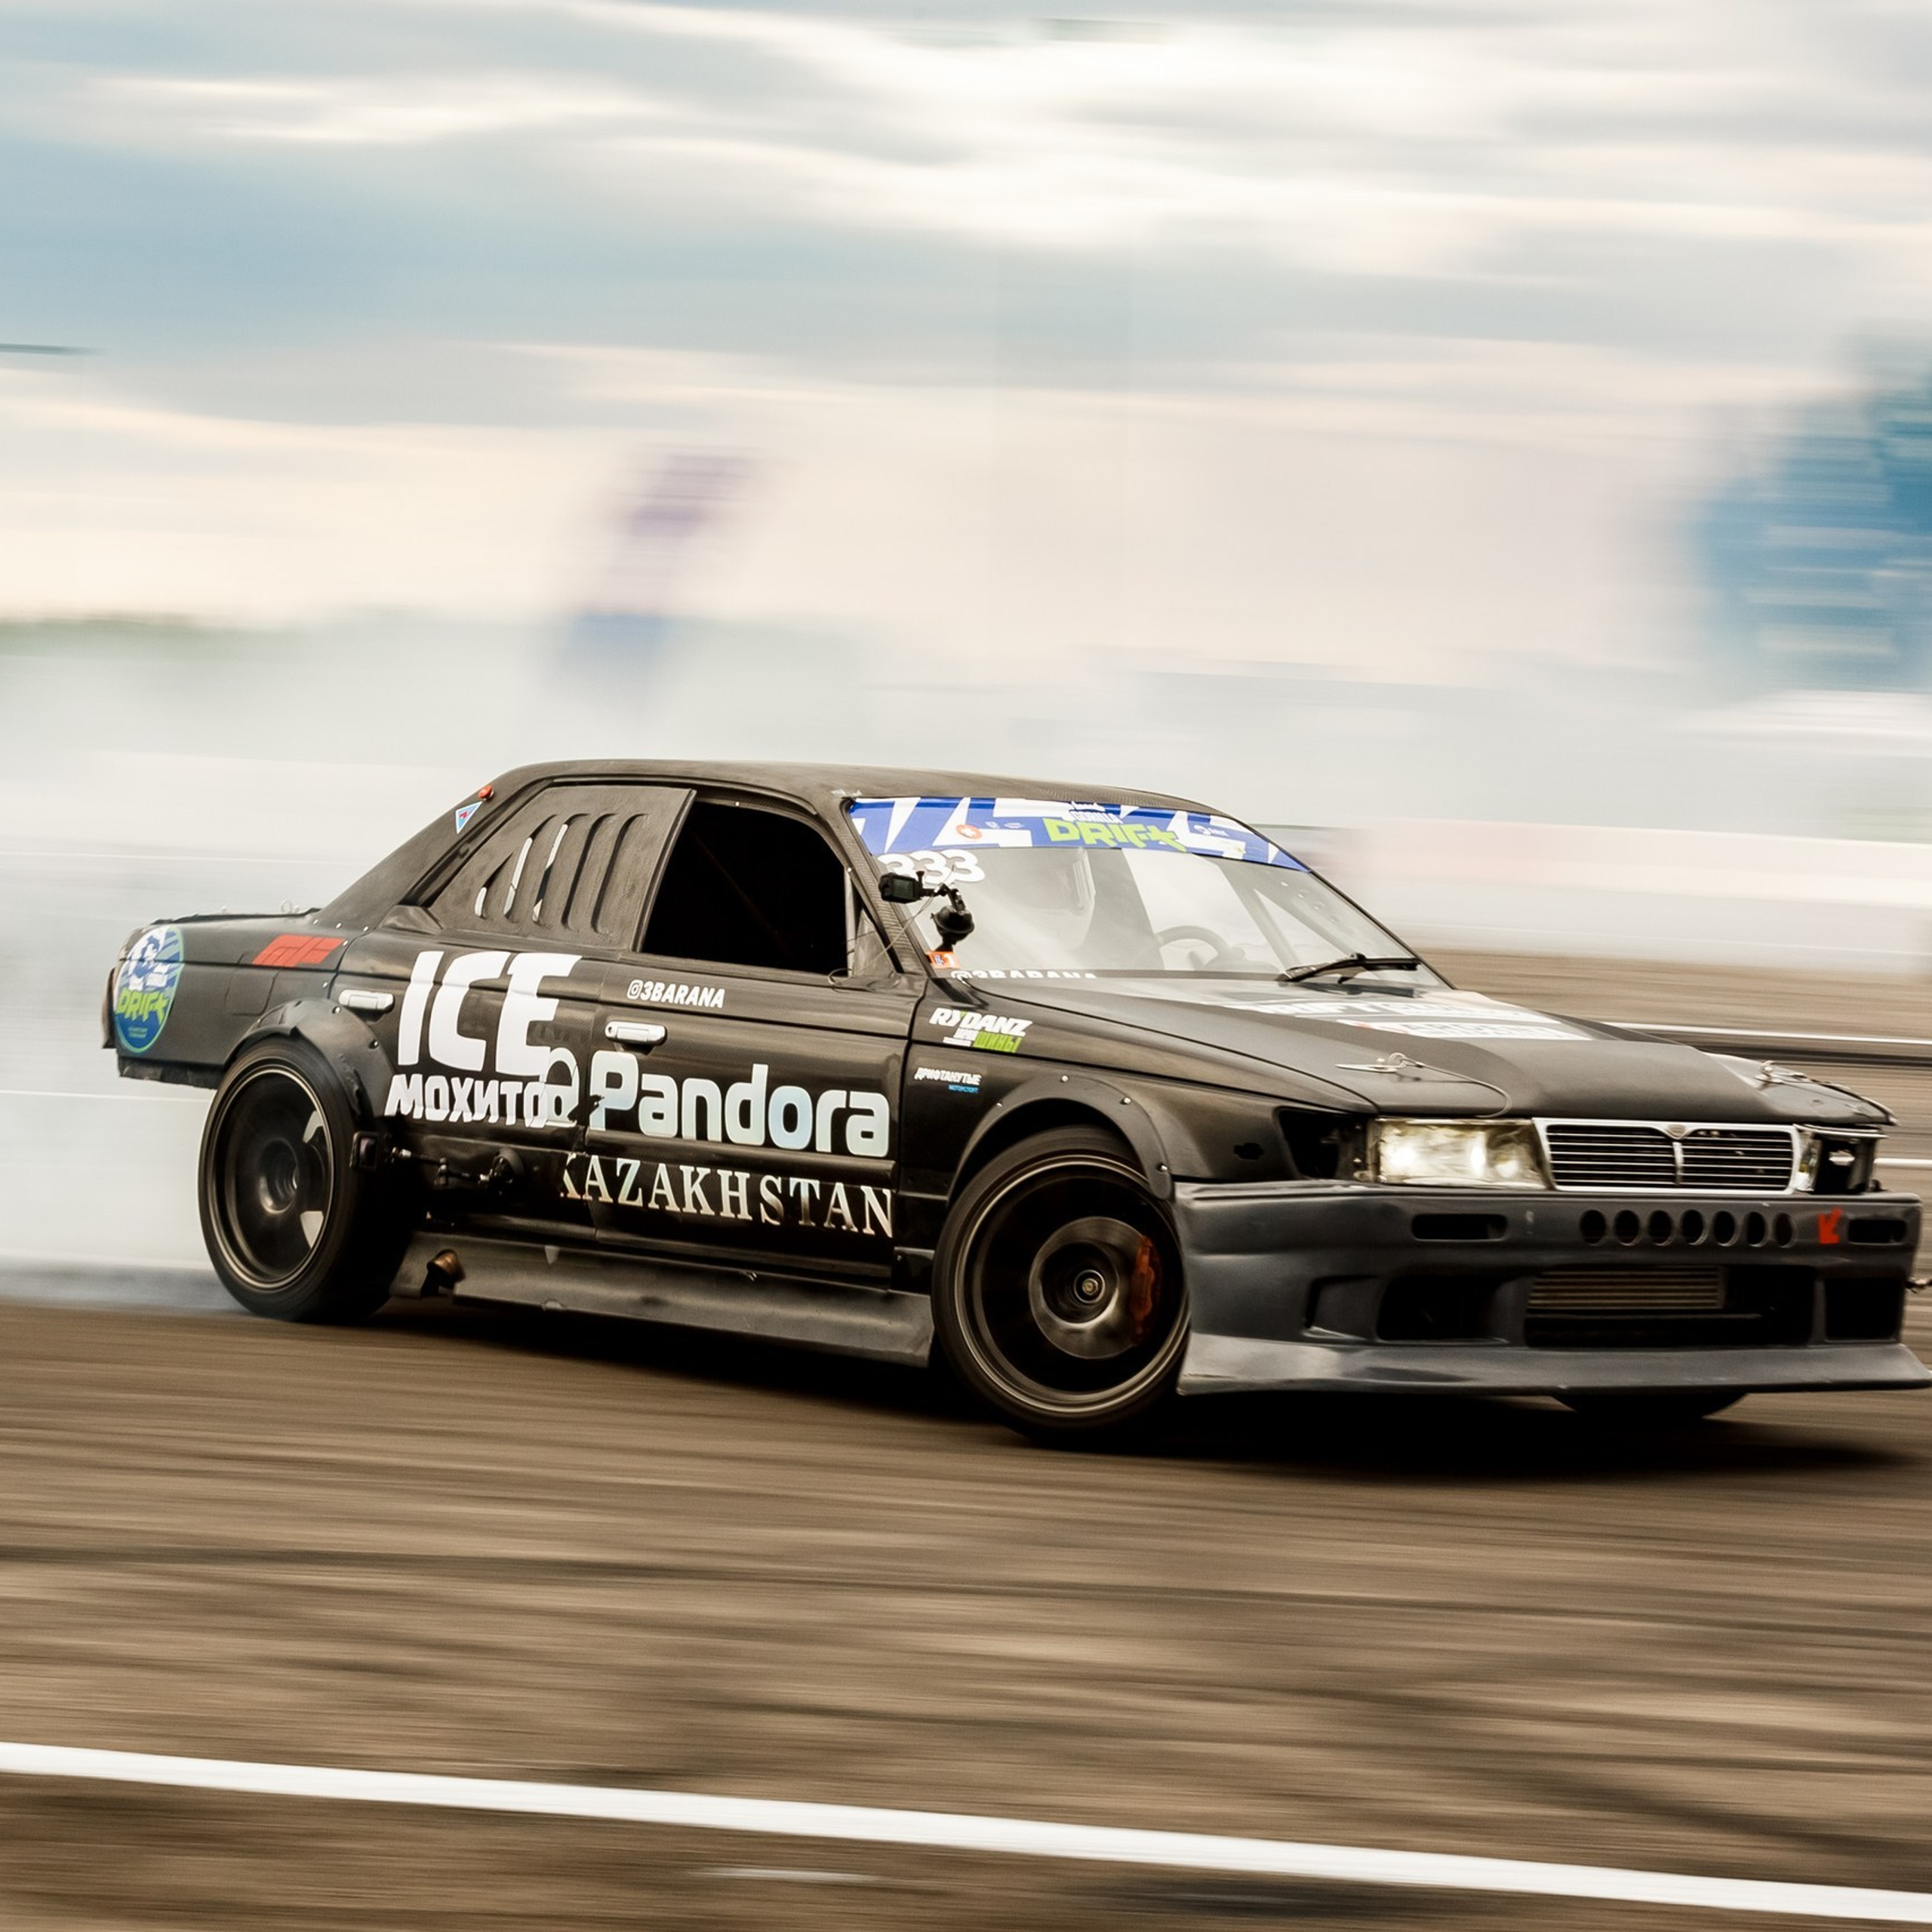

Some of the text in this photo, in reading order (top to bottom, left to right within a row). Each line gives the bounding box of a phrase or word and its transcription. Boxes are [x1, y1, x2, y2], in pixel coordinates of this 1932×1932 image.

[1042, 817, 1187, 853] DRIFT
[115, 988, 169, 1026] DRIFT
[398, 951, 583, 1077] ICE
[929, 1008, 1033, 1038] RYDANZ
[384, 1074, 549, 1128] МОХИТО
[589, 1050, 890, 1157] Pandora
